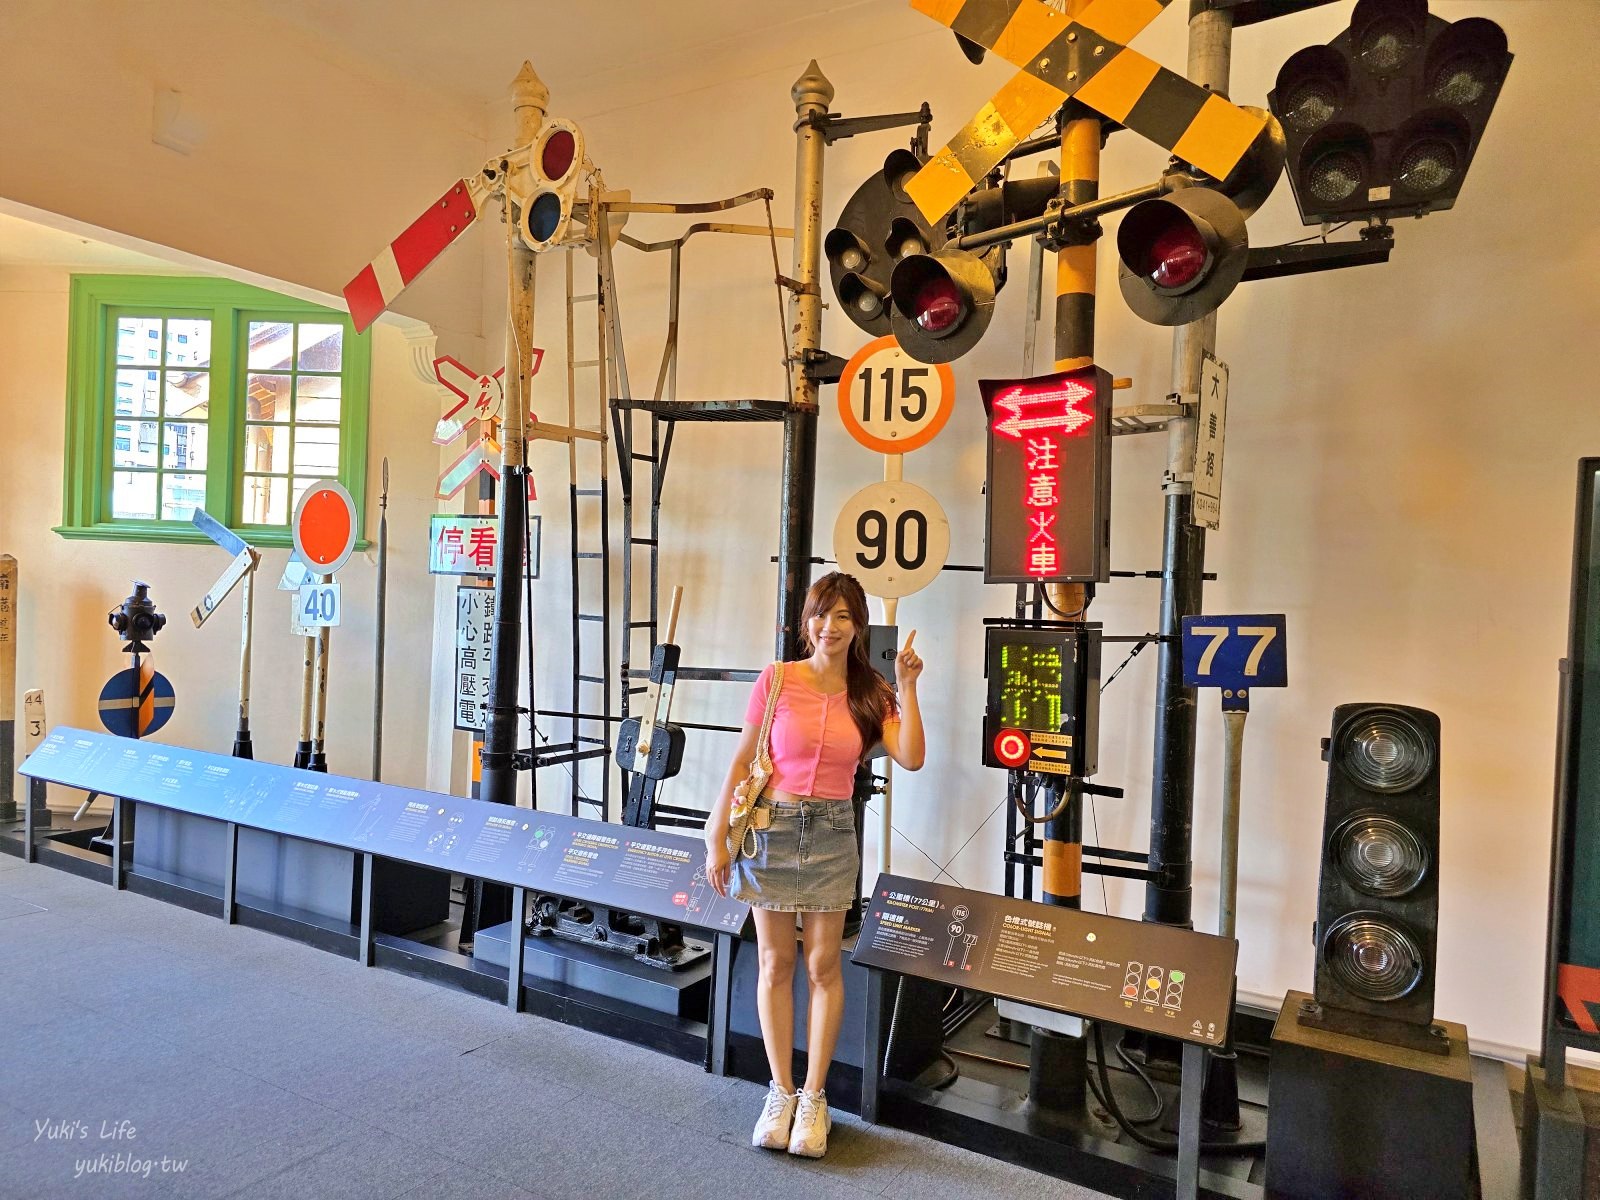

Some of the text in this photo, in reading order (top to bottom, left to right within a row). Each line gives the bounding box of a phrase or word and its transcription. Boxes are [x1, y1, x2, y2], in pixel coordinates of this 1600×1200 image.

[858, 367, 929, 423] 115
[1027, 437, 1059, 575] 注意火車
[437, 525, 532, 568] 停看
[855, 509, 928, 571] 90
[304, 588, 336, 622] 40
[459, 593, 479, 724] 小心高壓電
[1190, 626, 1277, 677] 77
[25, 694, 43, 706] 44
[30, 720, 41, 737] 3
[950, 924, 962, 934] 90
